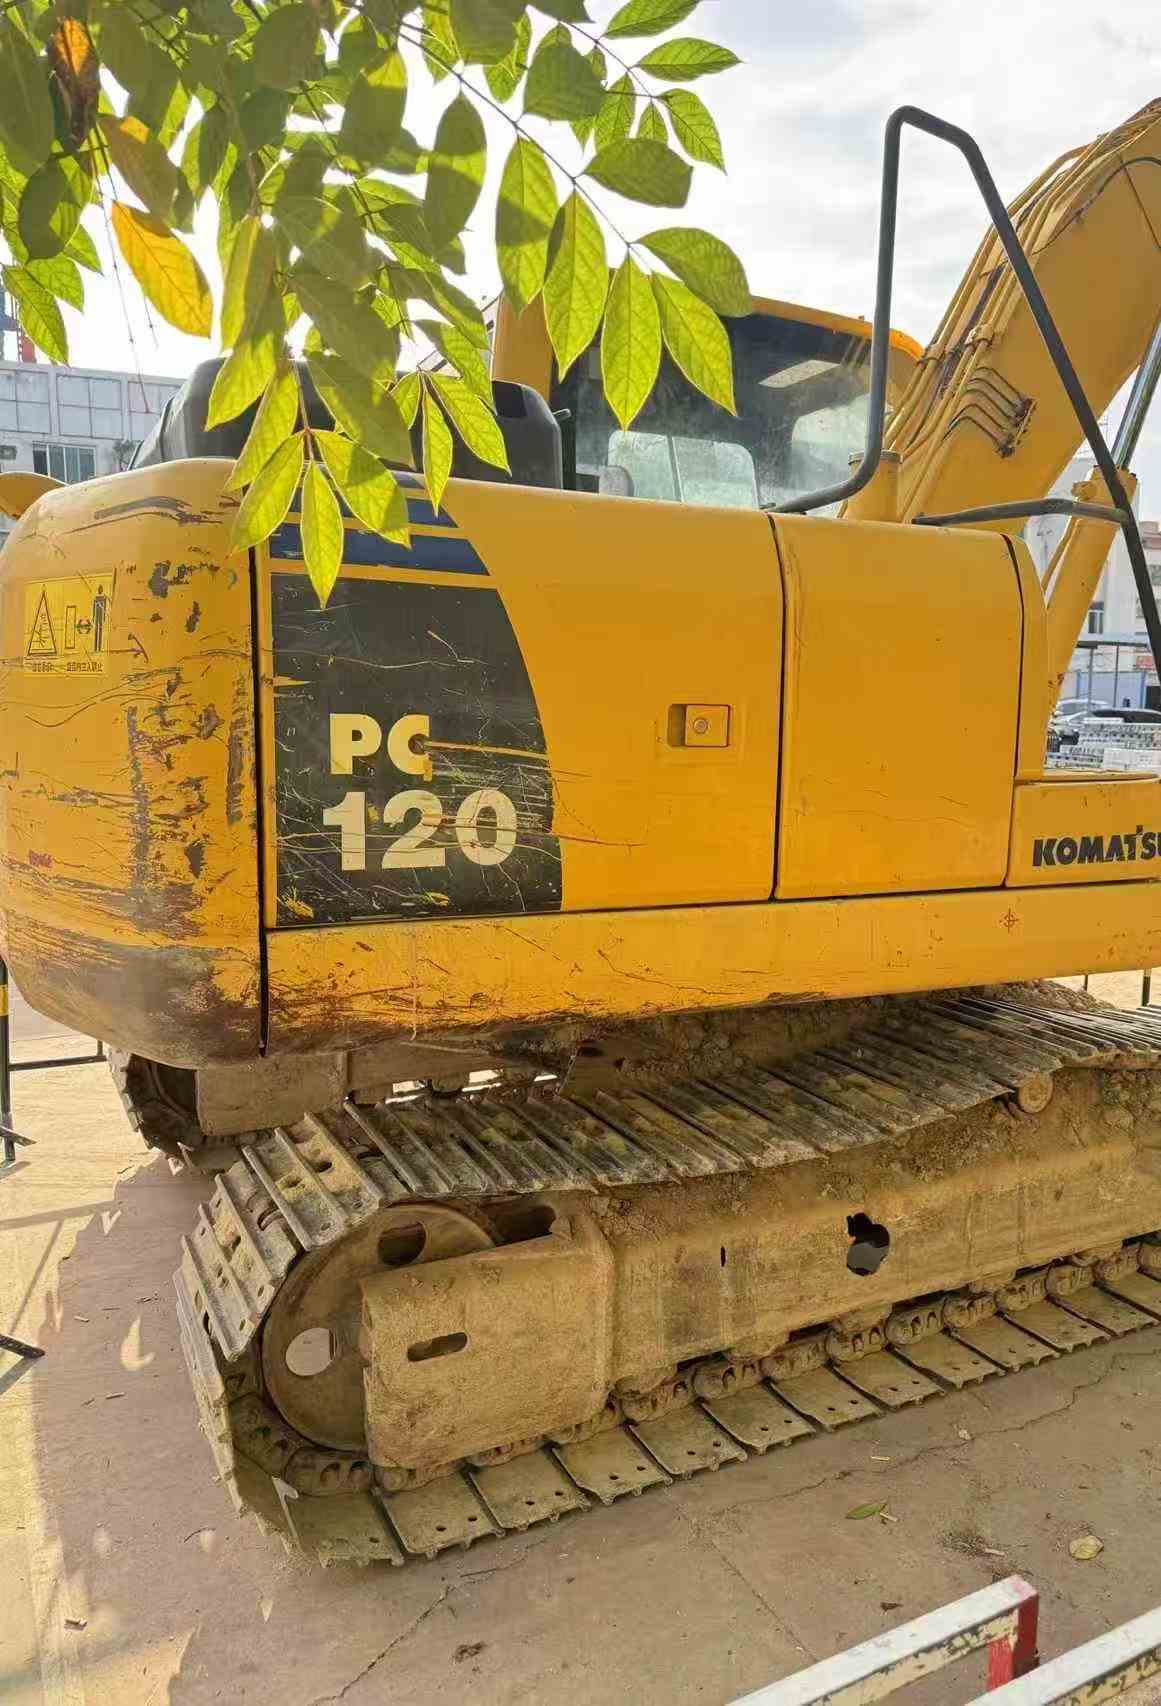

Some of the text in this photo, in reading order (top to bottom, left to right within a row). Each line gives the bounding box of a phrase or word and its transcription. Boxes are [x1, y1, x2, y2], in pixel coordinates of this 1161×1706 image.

[329, 713, 431, 776] PC
[323, 790, 517, 871] 120
[1032, 825, 1161, 867] KOMATS
